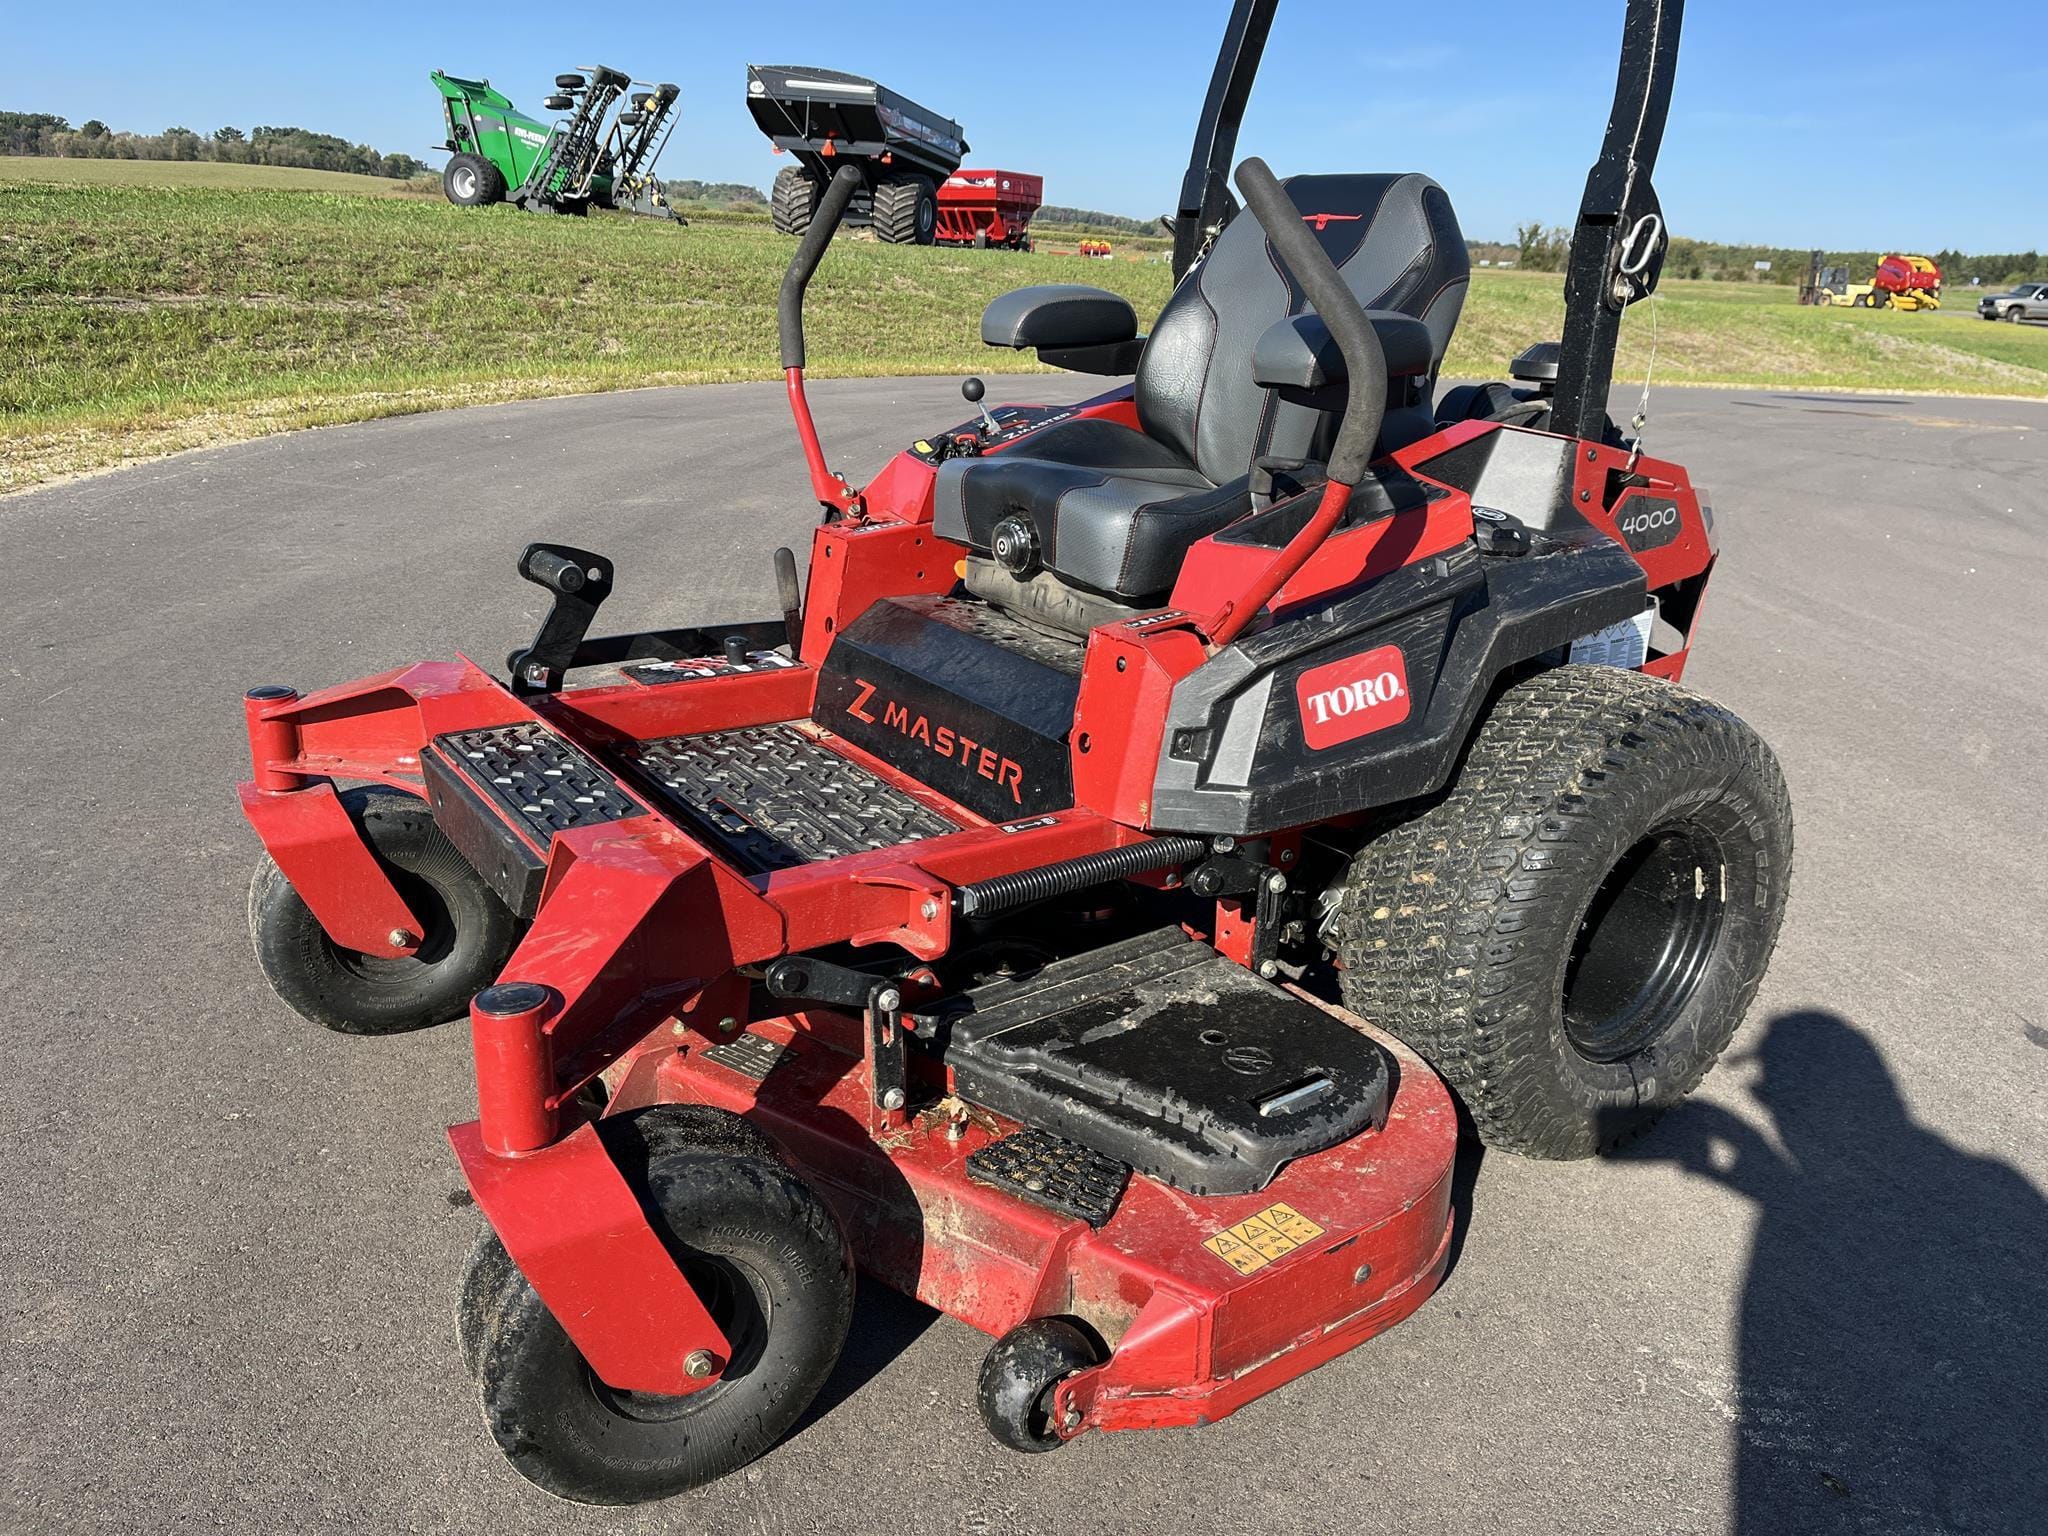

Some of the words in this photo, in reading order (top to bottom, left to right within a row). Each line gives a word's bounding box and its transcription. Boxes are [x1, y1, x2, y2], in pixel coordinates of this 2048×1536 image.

[1622, 507, 1676, 534] 4000
[1307, 672, 1400, 724] TORO
[846, 678, 877, 724] Z
[883, 701, 1023, 805] MASTER
[780, 1243, 815, 1291] WHEEL
